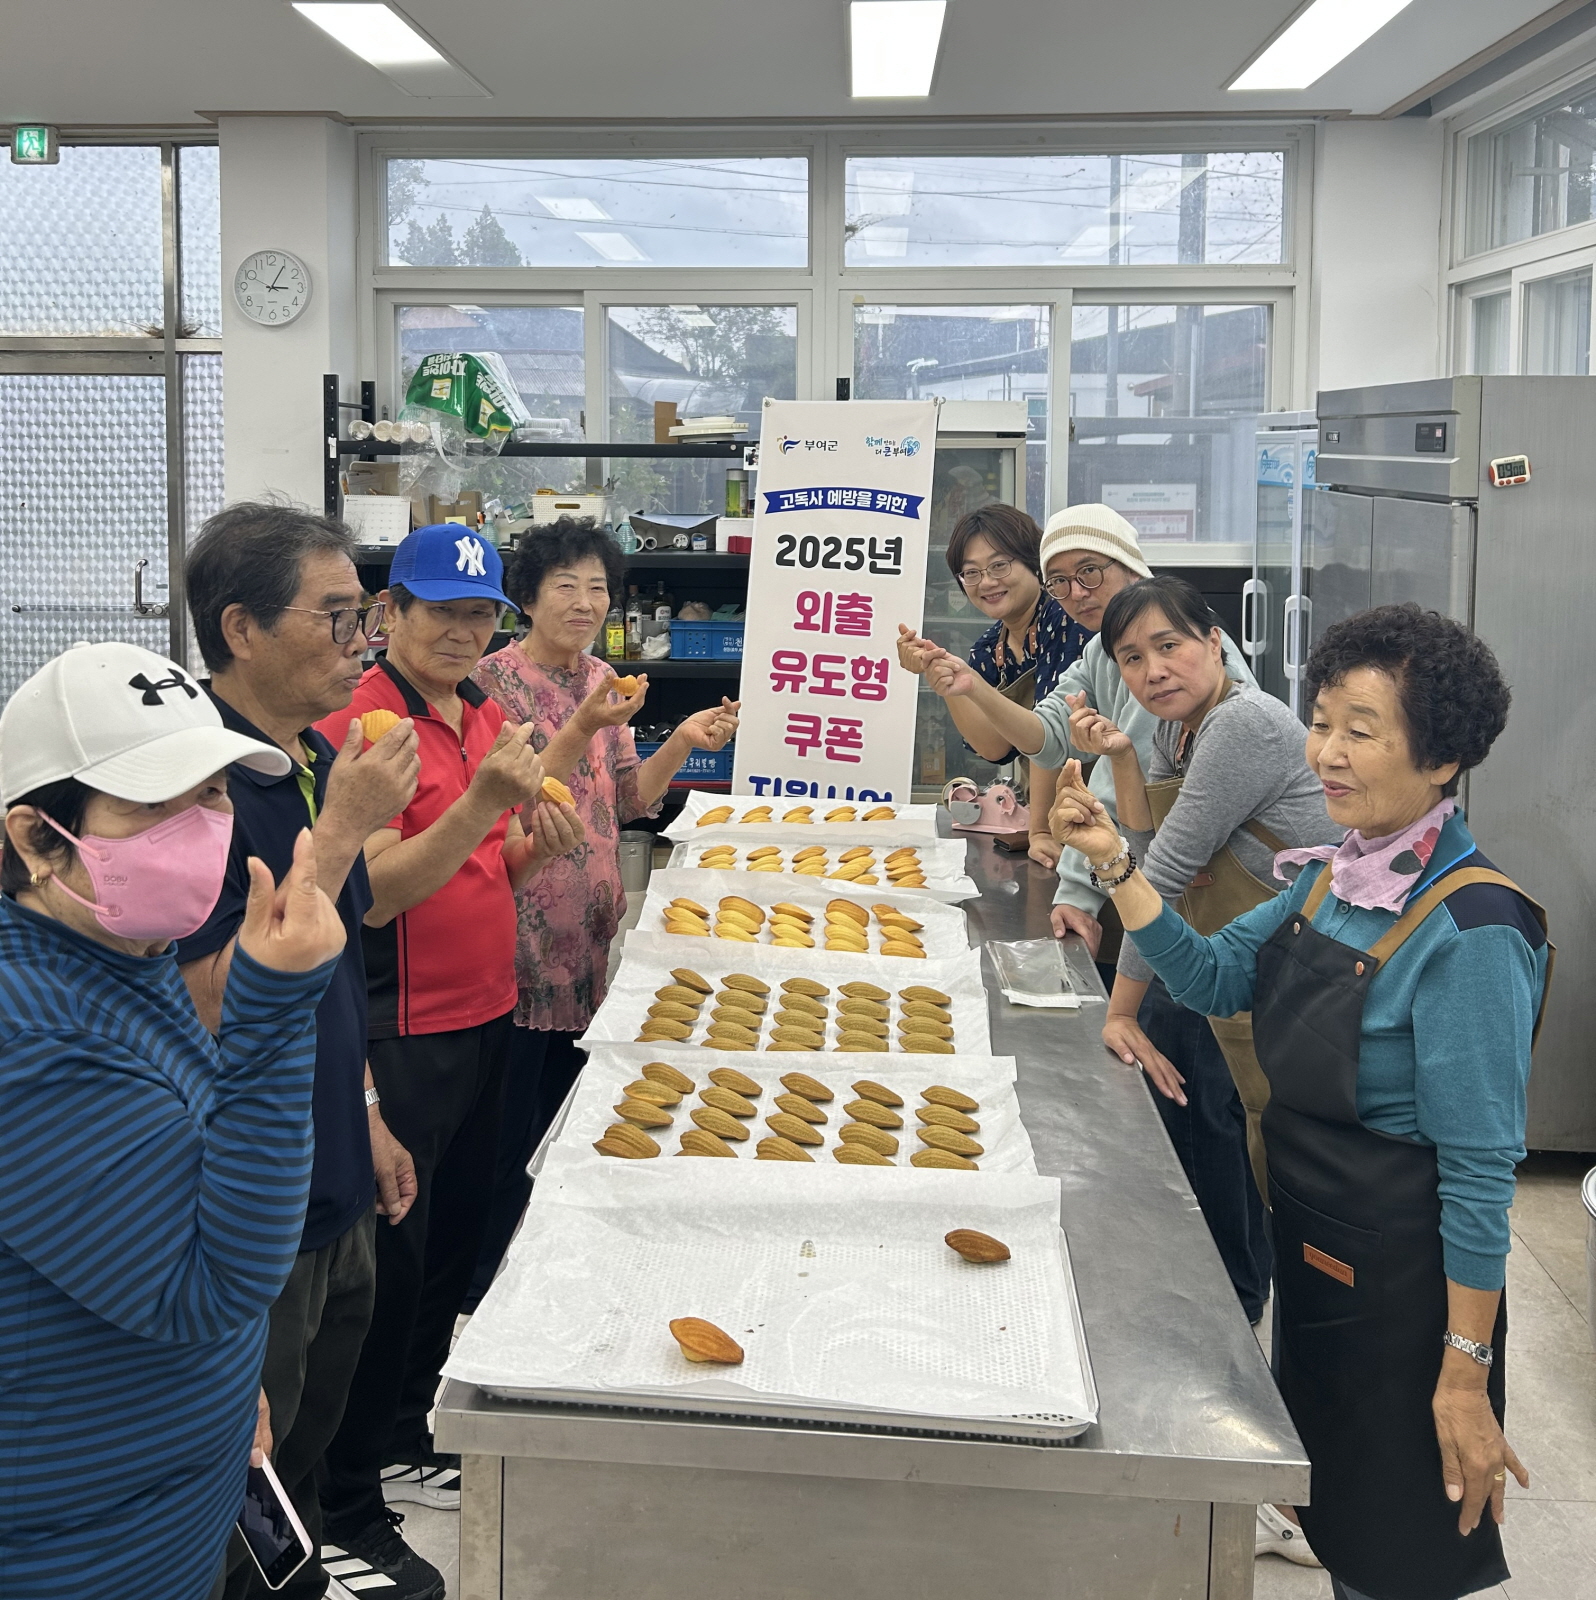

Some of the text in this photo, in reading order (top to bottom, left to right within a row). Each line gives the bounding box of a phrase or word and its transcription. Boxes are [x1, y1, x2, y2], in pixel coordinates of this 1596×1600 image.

[255, 259, 263, 270] 11
[266, 255, 276, 266] 12
[245, 270, 257, 280] 10
[291, 268, 299, 279] 2
[240, 282, 248, 292] 9
[297, 282, 304, 293] 3
[246, 296, 253, 306] 8
[292, 296, 299, 306] 4
[256, 306, 263, 316] 7
[269, 309, 276, 320] 6
[283, 306, 290, 317] 5
[422, 359, 468, 376] 자이언트
[804, 440, 838, 451] 부여군
[865, 436, 883, 447] 함께
[883, 447, 891, 457] 큰
[893, 447, 907, 457] 부여
[779, 490, 908, 514] 고독사 예방을 위한
[454, 536, 487, 576] NY
[776, 534, 903, 575] 2025년
[793, 591, 873, 637] 외출
[769, 650, 889, 701] 유도형
[784, 713, 863, 763] 쿠폰
